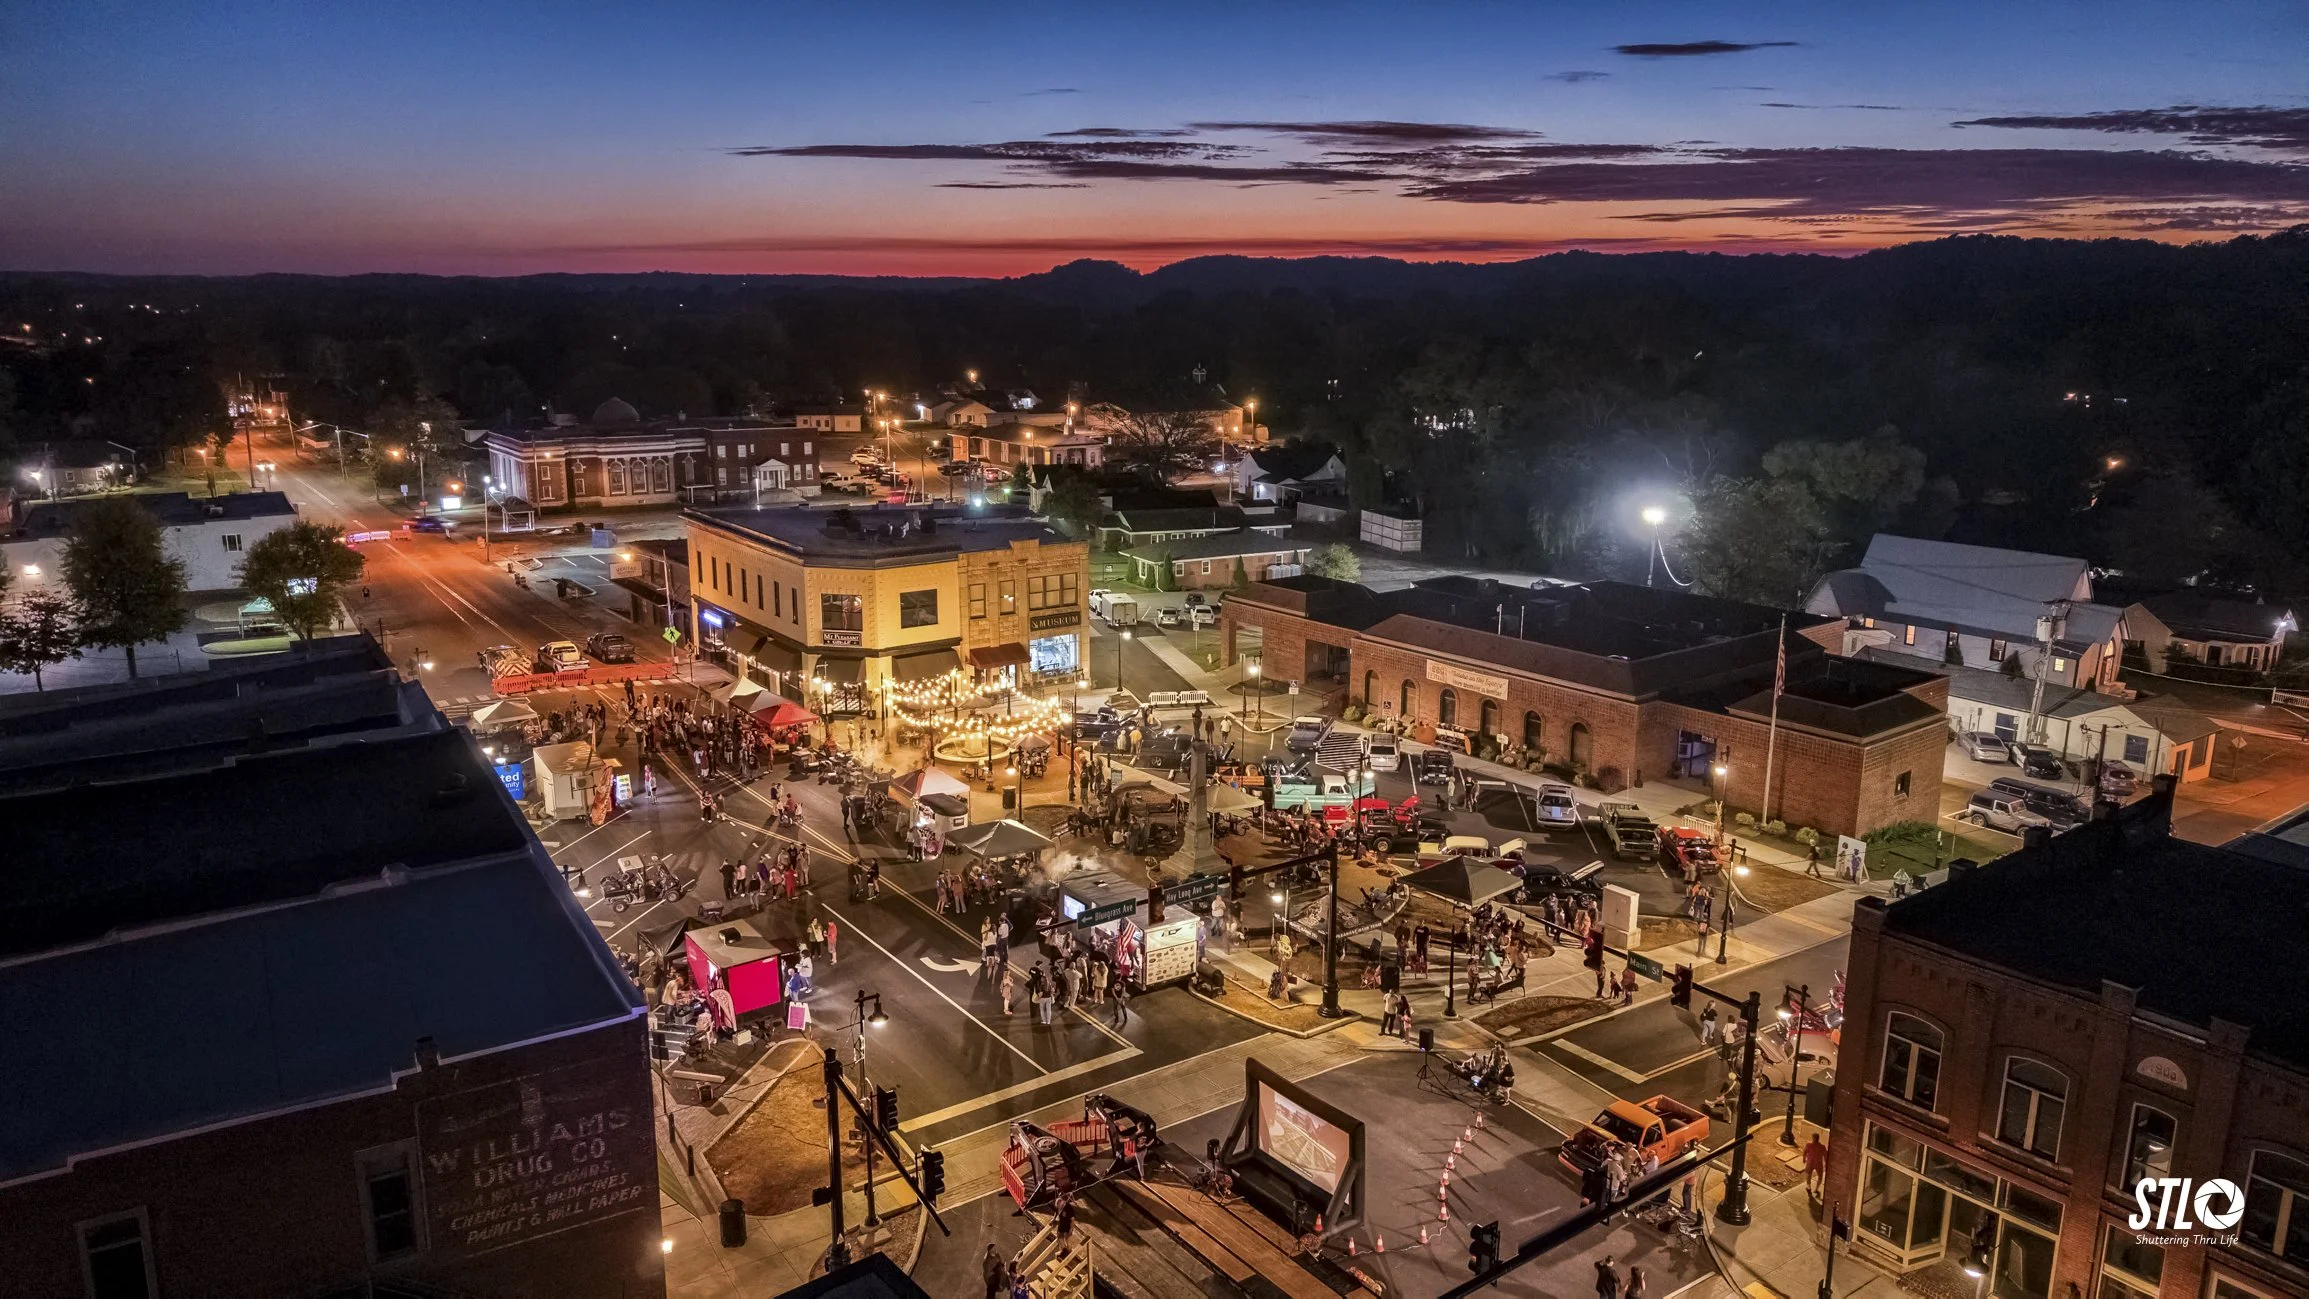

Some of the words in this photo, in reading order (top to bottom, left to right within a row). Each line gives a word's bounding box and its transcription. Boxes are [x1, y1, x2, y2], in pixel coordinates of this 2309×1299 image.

[1039, 615, 1079, 628] MUSEUM
[1178, 889, 1191, 899] Long
[1192, 886, 1203, 896] Ave
[1094, 907, 1121, 921] Bluegrass
[1122, 904, 1134, 914] Ave
[1629, 956, 1647, 971] Main
[1651, 966, 1660, 977] St
[428, 1109, 631, 1174] WILLIAMS
[474, 1153, 552, 1188] DRUG
[571, 1137, 606, 1163] CO
[450, 1196, 540, 1231] CHEMICALS
[544, 1171, 629, 1206] MEDICINES
[466, 1216, 526, 1245] PAINTS
[530, 1212, 541, 1226] &
[546, 1201, 584, 1222] WALL
[588, 1184, 642, 1212] PAPER
